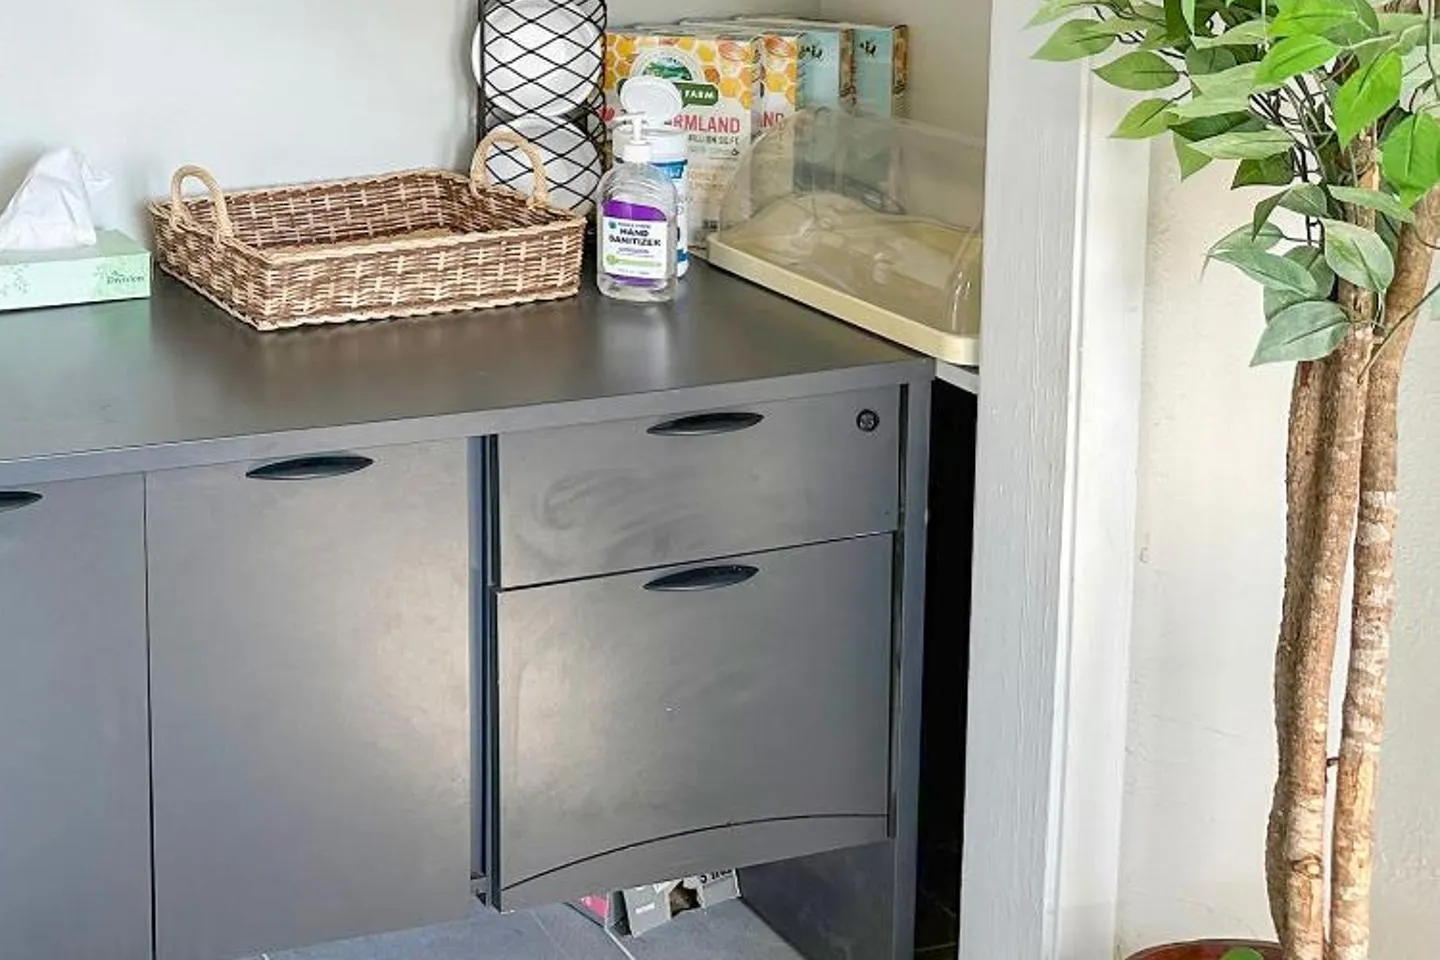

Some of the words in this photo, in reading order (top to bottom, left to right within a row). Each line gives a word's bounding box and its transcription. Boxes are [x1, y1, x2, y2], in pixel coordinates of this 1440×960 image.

[672, 114, 740, 133] RMLAND
[619, 228, 650, 237] HAND
[608, 234, 662, 247] SANITIZER
